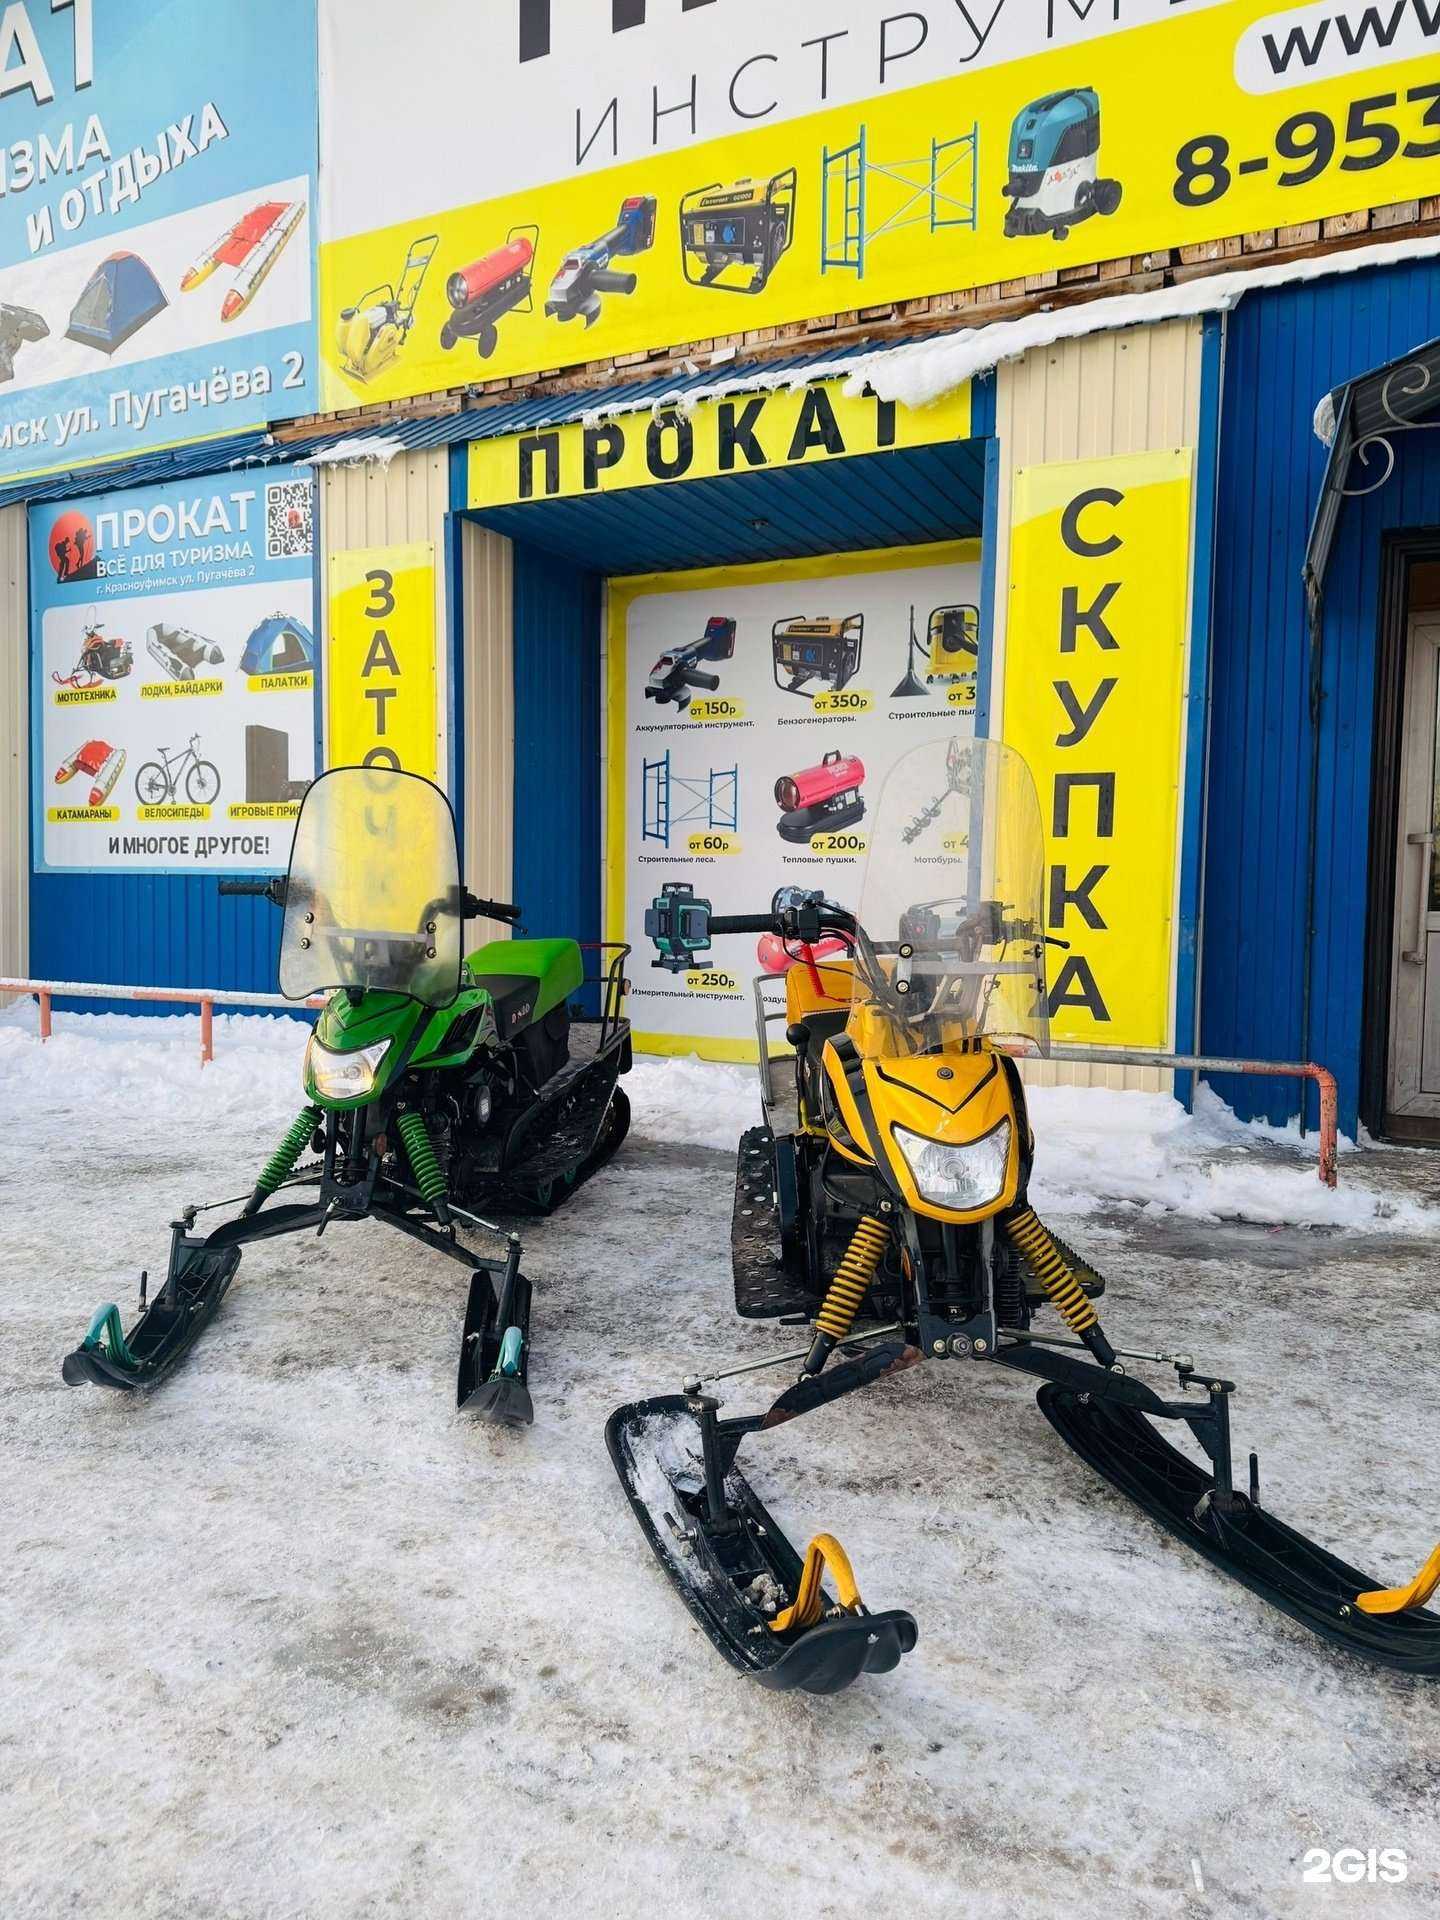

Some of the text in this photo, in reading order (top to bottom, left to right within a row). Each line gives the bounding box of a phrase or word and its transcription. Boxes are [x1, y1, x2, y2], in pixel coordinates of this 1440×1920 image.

[0, 113, 111, 198] ЗМА
[26, 102, 229, 253] И ОТДЫХА
[54, 406, 100, 447] ул.
[109, 365, 272, 431] Пугачёва
[281, 350, 305, 390] 2
[96, 491, 256, 551] ПРОКАТ
[96, 541, 254, 577] ВСЁ ДЛЯ ТУРИЗМА
[106, 577, 177, 594] Красноуфимск
[180, 574, 194, 586] ул.
[197, 566, 246, 584] Пугачёва
[248, 565, 256, 576] 2
[141, 680, 223, 699] ЛОДКИ, БАЙДАРКИ
[261, 676, 308, 689] ПАЛАТКИ
[57, 691, 117, 704] МОТОТЕХНИКА
[814, 694, 867, 709] от 350р
[948, 692, 962, 701] от
[690, 700, 736, 716] от 150р
[888, 710, 956, 721] Строительные
[635, 720, 755, 733] Аккумуляторный инструмент.
[777, 715, 857, 726] Бензогенераторы.
[1028, 487, 1125, 1022] СКУПКА
[57, 808, 112, 820] КАТАМАРАНЫ
[144, 807, 205, 818] ВЕЛОСИПЕДЫ
[230, 806, 274, 817] ИГРОВЫЕ
[109, 836, 270, 858] И МНОГОЕ ДРУГОЕ!
[703, 836, 729, 851] 60р
[811, 836, 866, 851] от 200р
[943, 840, 957, 849] от
[638, 855, 694, 864] Строительные
[782, 856, 857, 865] Тепловые пушки.
[701, 973, 735, 988] 250р
[631, 987, 745, 1002] Измерительный инструмент.
